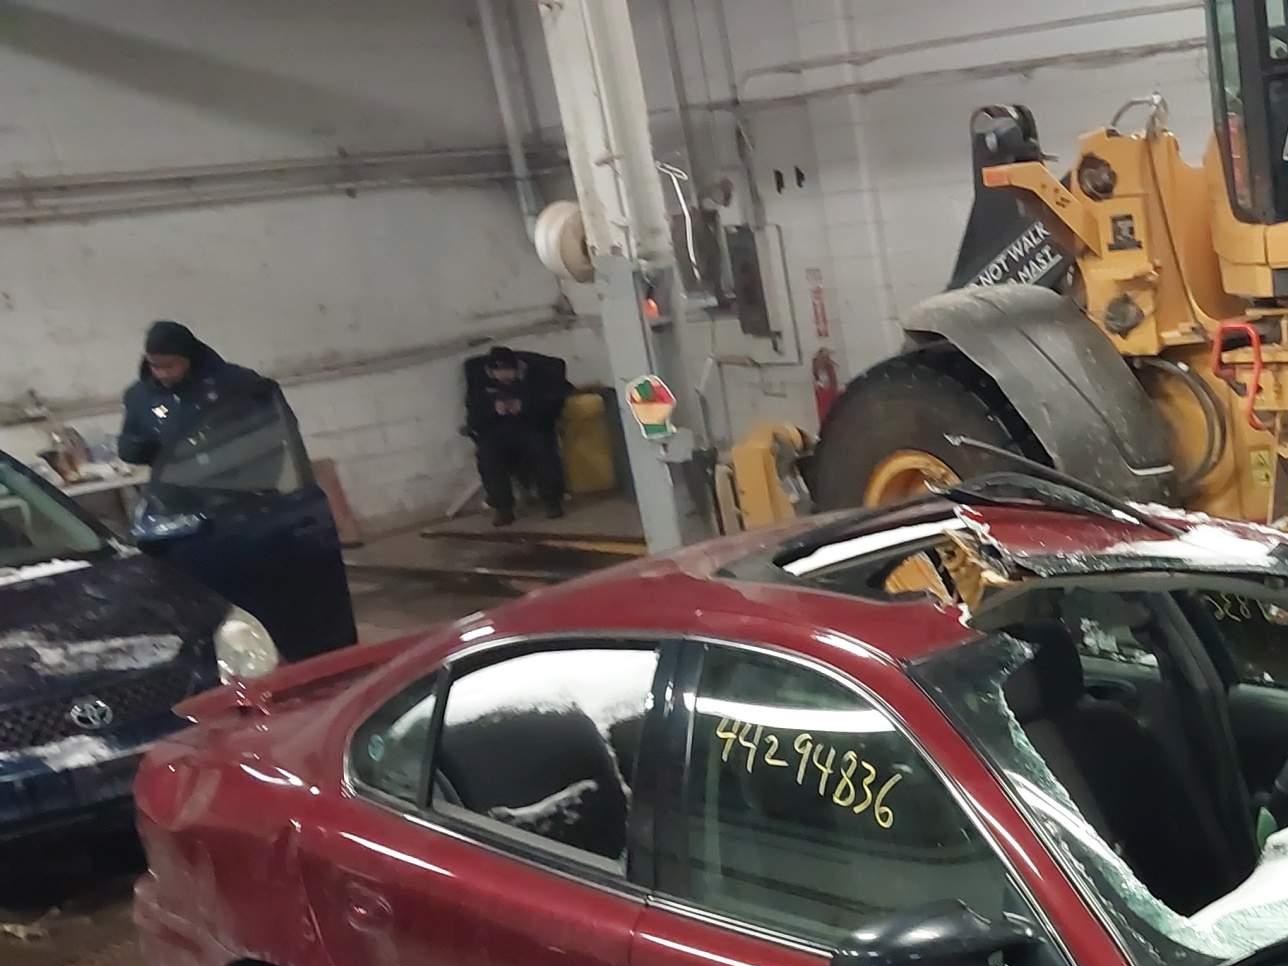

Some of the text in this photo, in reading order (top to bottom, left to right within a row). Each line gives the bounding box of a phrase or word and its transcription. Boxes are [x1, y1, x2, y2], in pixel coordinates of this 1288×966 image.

[978, 221, 1051, 287] NOT WALK
[716, 717, 902, 828] 44294836
